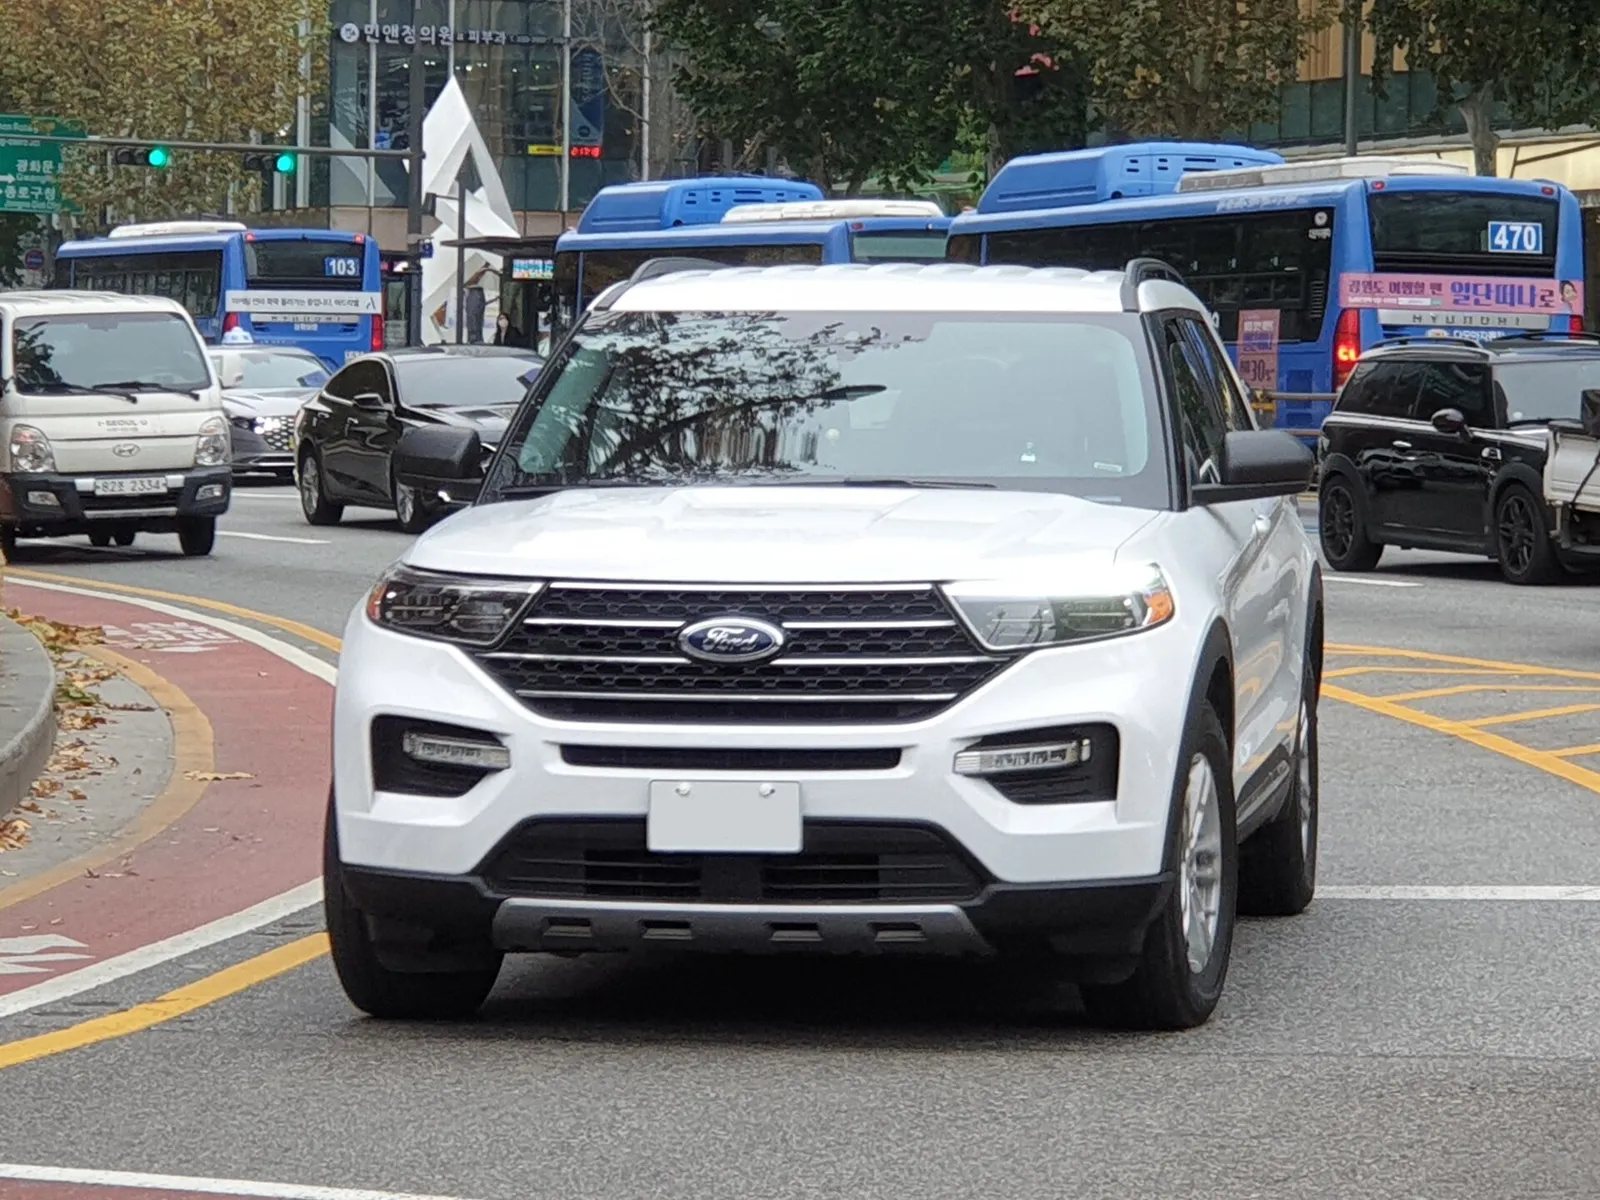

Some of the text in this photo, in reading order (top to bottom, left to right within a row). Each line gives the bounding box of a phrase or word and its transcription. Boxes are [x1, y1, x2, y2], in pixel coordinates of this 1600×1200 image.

[468, 30, 506, 45] 피부과
[16, 159, 53, 174] 광화문
[5, 185, 56, 201] 종로구청
[1494, 225, 1537, 250] 470
[329, 258, 356, 276] 103
[1349, 280, 1385, 294] 강원도
[1412, 314, 1520, 326] HYUNDAI
[130, 479, 161, 492] 2334
[702, 626, 759, 651] Ford
